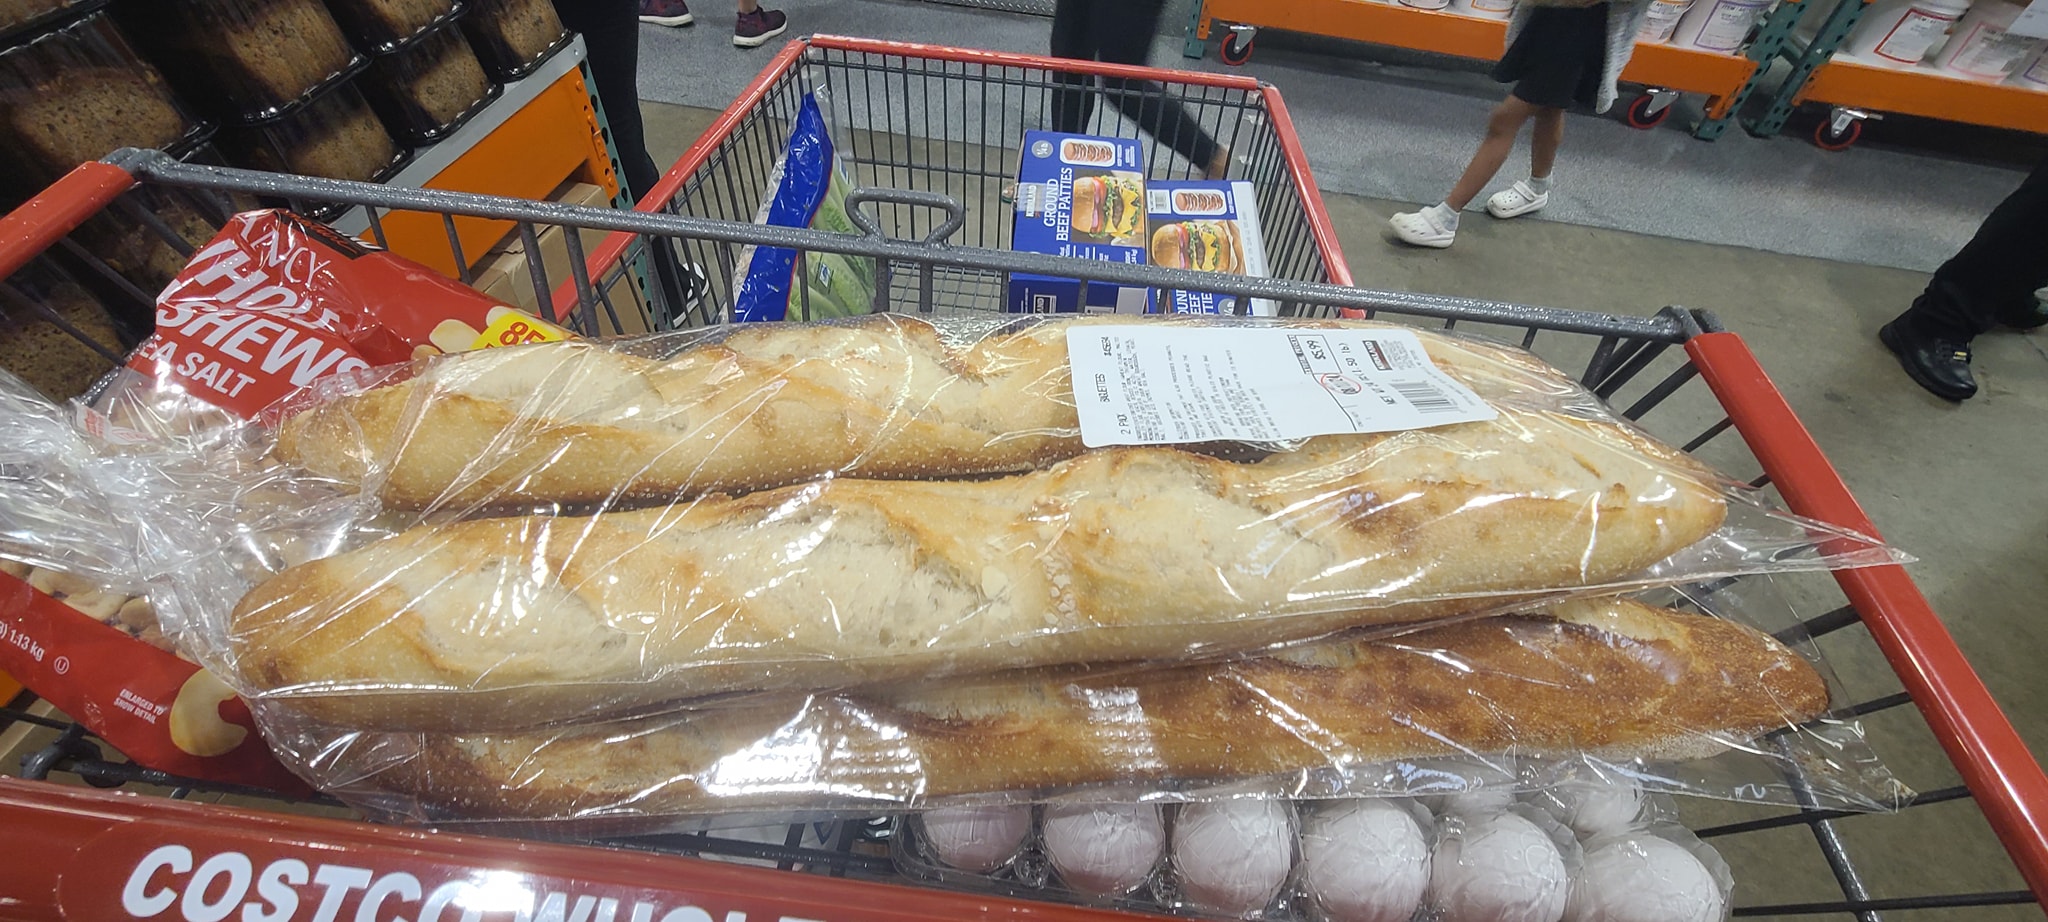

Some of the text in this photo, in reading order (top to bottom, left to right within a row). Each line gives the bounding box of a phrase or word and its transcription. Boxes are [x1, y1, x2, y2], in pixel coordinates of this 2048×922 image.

[1043, 178, 1059, 227] GROUND
[1055, 167, 1073, 241] BEEF PATTIES
[176, 351, 257, 398] SALT
[10, 629, 30, 651] 1.13
[29, 640, 45, 662] kg
[114, 697, 136, 712] SHOW
[120, 689, 154, 711] ENLARGED
